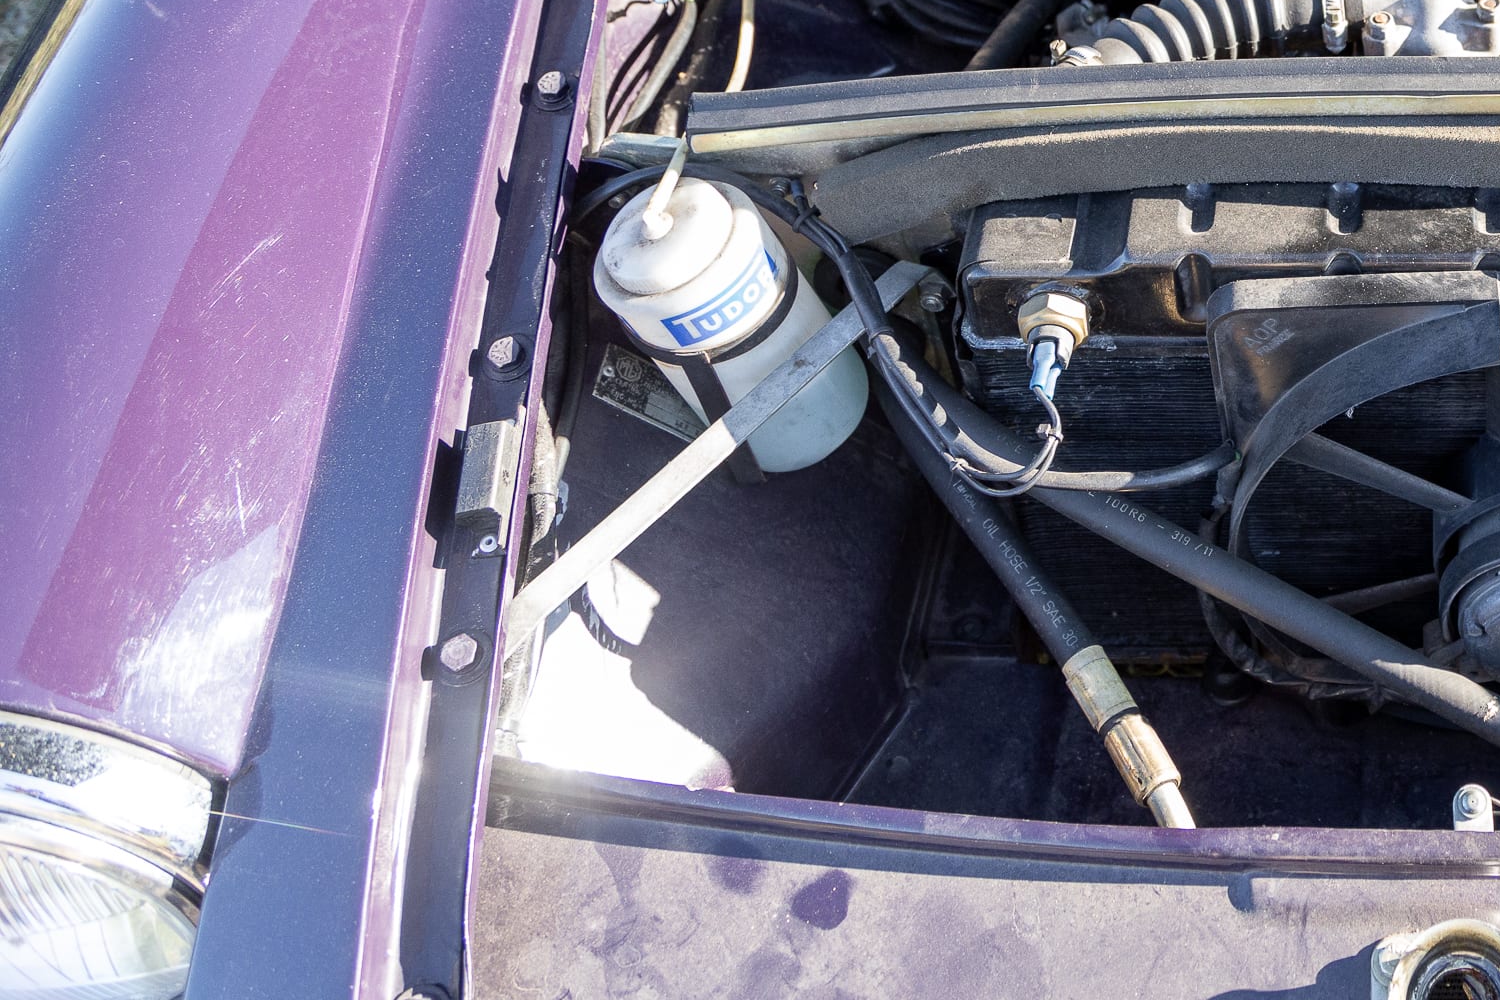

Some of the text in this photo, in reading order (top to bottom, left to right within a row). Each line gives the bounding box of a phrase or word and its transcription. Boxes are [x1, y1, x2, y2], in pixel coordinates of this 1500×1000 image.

[671, 263, 774, 340] TUDOR
[1105, 495, 1147, 522] 100R6
[982, 518, 1001, 539] OIL
[999, 540, 1028, 575] HOSE
[1042, 600, 1066, 628] SAE
